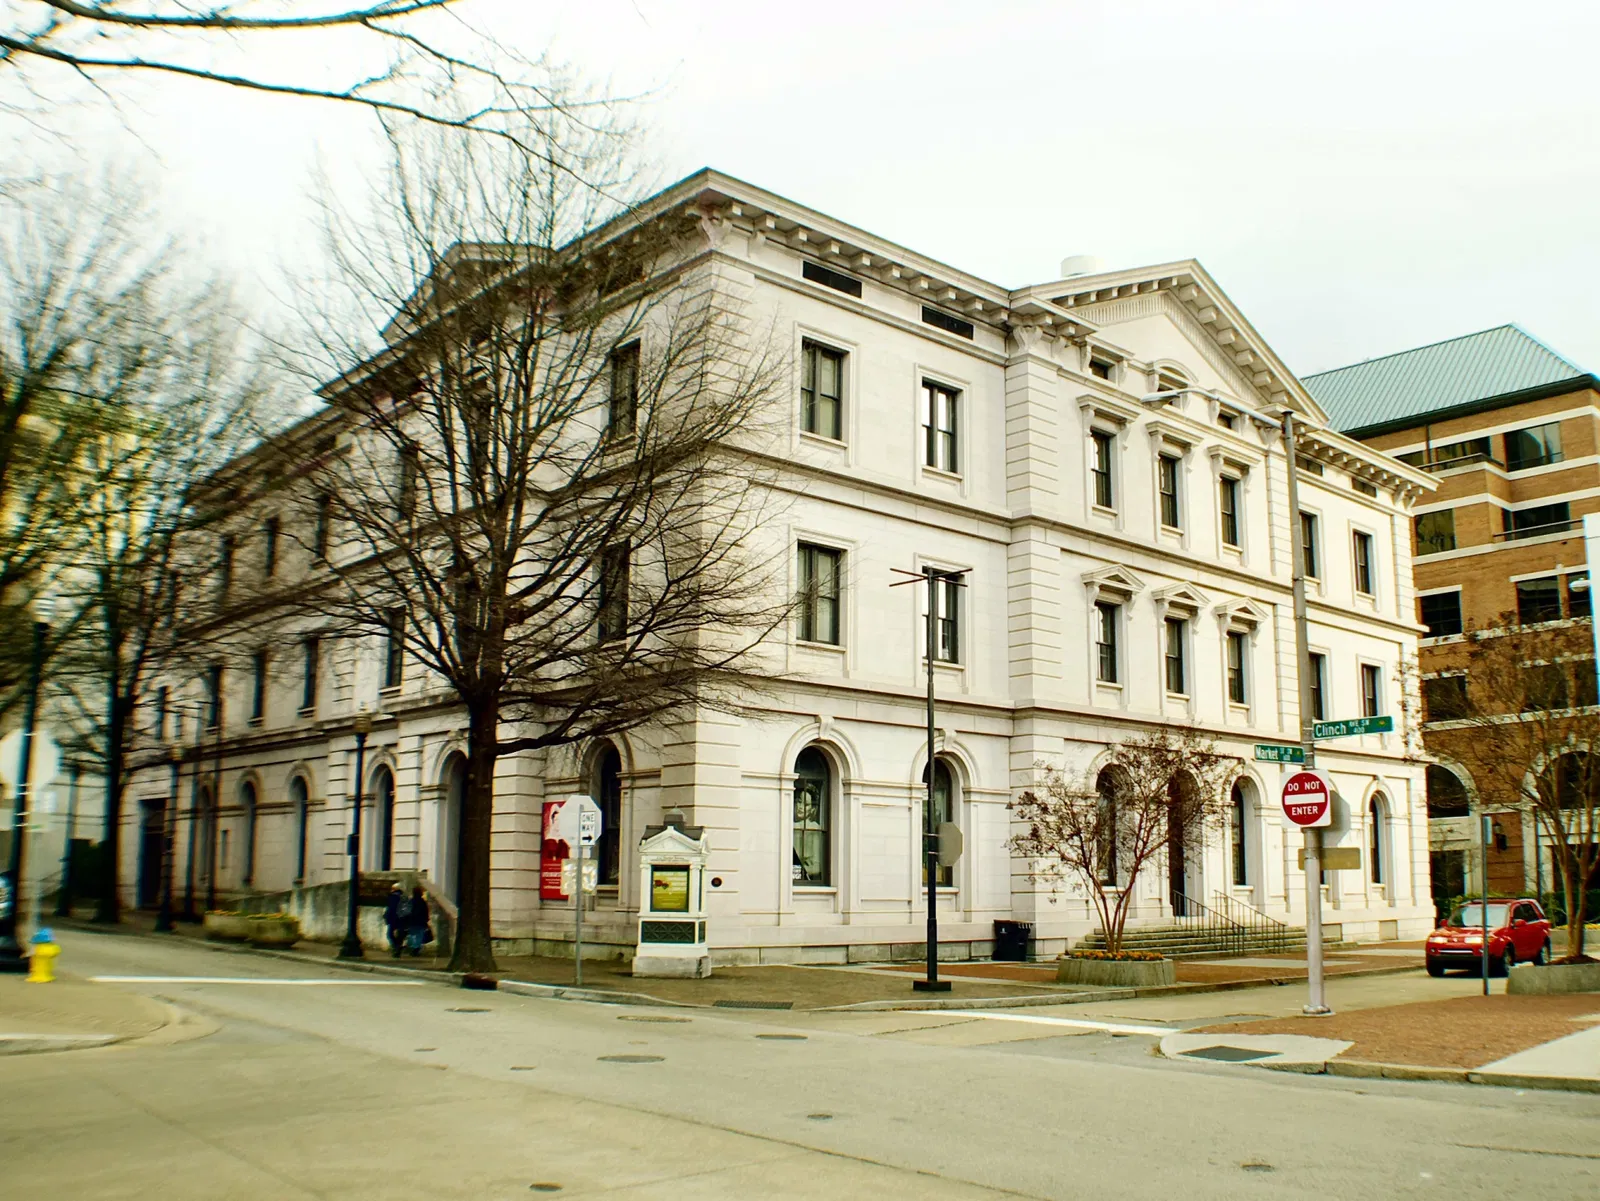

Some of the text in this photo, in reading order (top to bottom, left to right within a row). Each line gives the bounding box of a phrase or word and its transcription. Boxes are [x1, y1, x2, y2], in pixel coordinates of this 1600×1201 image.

[1315, 722, 1347, 737] Clinch
[1255, 746, 1279, 760] Market
[1287, 780, 1320, 792] DO NOT
[1291, 805, 1318, 816] ENTER
[581, 813, 595, 823] ONE
[581, 824, 595, 832] WAY
